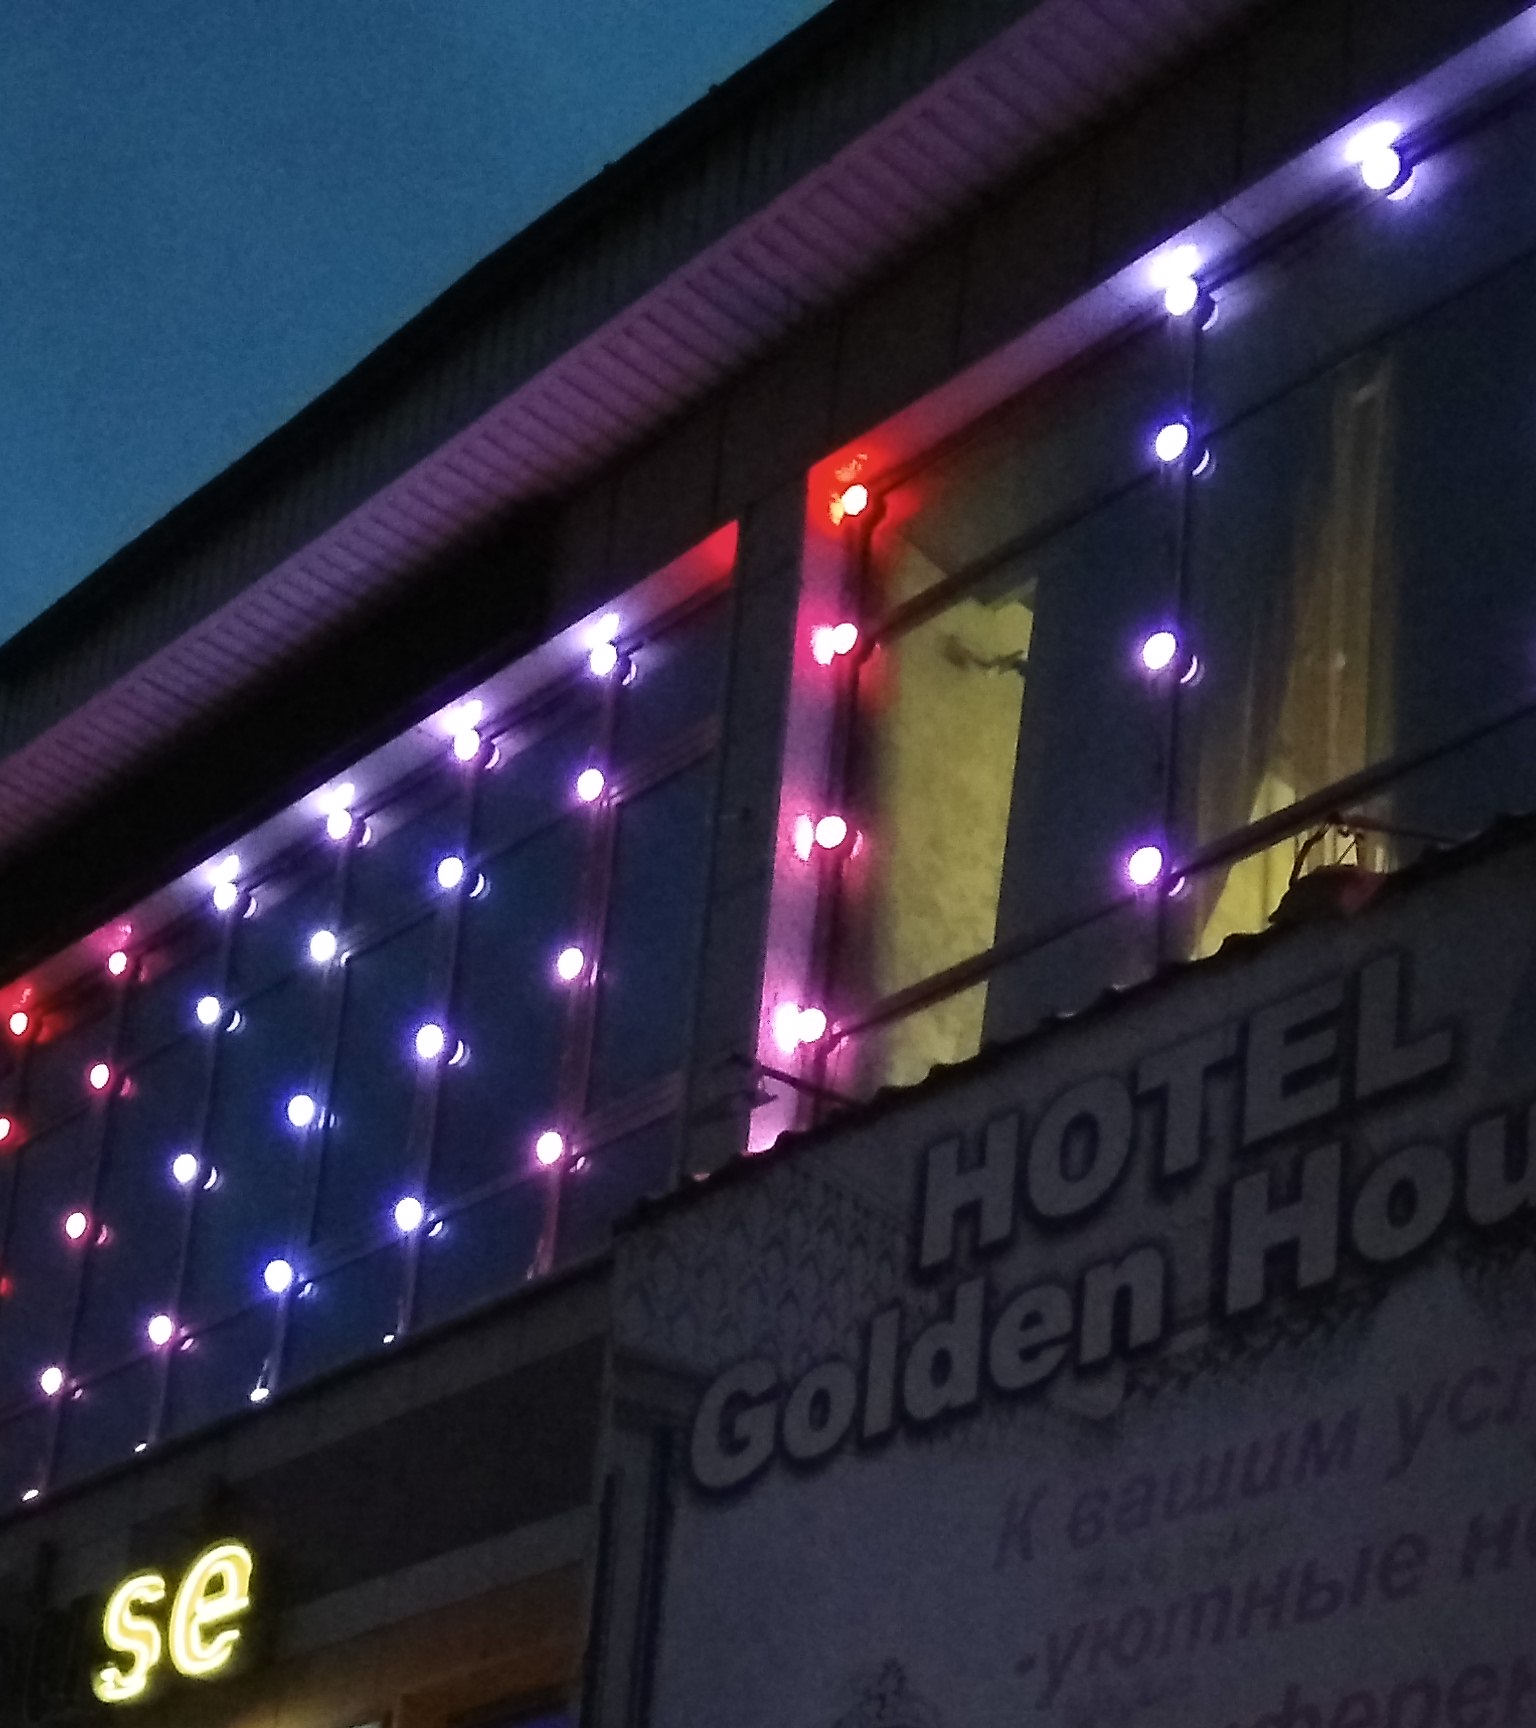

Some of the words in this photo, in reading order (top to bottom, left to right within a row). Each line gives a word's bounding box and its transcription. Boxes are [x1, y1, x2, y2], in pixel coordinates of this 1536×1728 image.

[914, 945, 1456, 1272] HOTEL
[688, 1240, 1170, 1494] Golden
[994, 1484, 1046, 1572] К
[1068, 1402, 1362, 1552] вашим
[1012, 1526, 1434, 1714] -уютные
